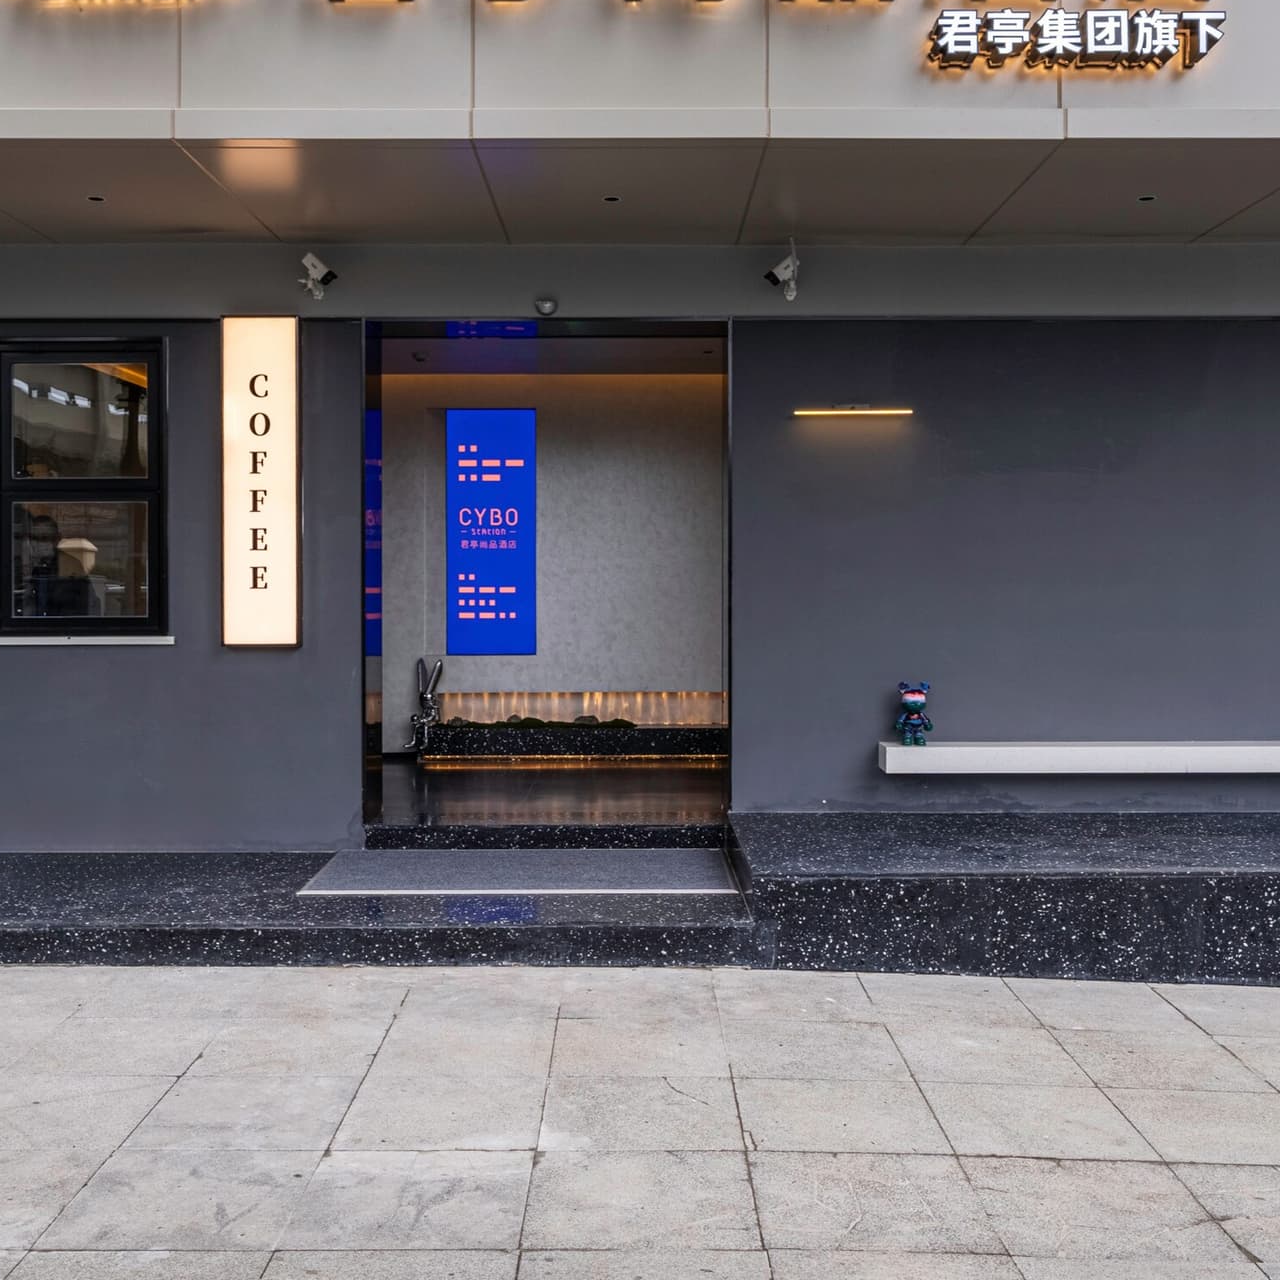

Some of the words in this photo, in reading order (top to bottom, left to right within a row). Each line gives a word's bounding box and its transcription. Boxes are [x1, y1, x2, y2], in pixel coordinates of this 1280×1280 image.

[937, 8, 1226, 54] 君亭集团旗下
[249, 373, 271, 590] COFFEE
[459, 507, 519, 526] CYBO
